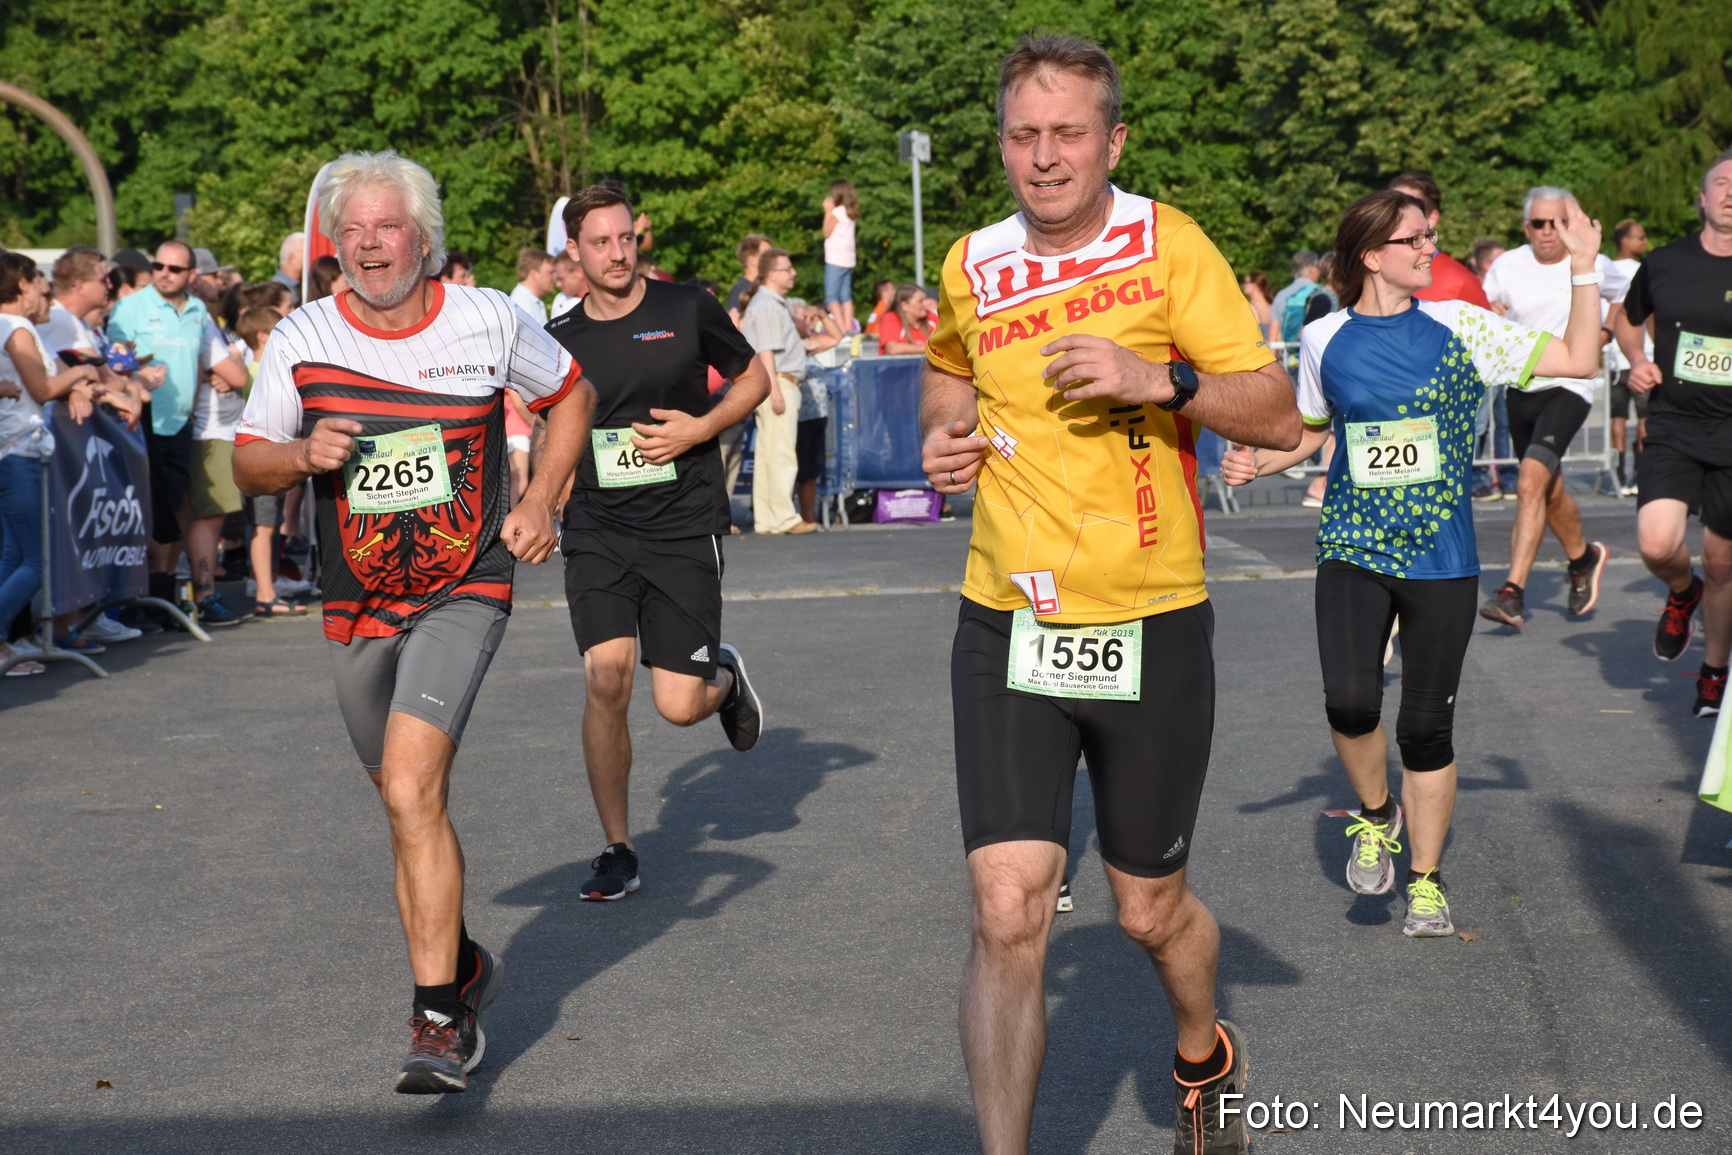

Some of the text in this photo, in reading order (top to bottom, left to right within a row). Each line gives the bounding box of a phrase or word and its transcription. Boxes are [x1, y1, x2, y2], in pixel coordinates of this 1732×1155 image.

[978, 276, 1165, 357] MAX BÖGL
[1683, 350, 1732, 372] 2080
[418, 364, 486, 380] NEUMARKT
[418, 445, 437, 455] 2019
[1367, 443, 1418, 469] 220
[355, 455, 434, 491] 2265
[1394, 467, 1421, 475] Melanie
[366, 486, 429, 500] Sichert Stephan
[392, 496, 419, 504] Neumarkt
[1111, 629, 1135, 638] 2019
[1028, 634, 1124, 672] 1556
[1032, 669, 1118, 684] Dorner Siegmund
[1027, 678, 1042, 686] Max
[1060, 681, 1097, 690] Bauservice
[1098, 683, 1120, 691] GmbH
